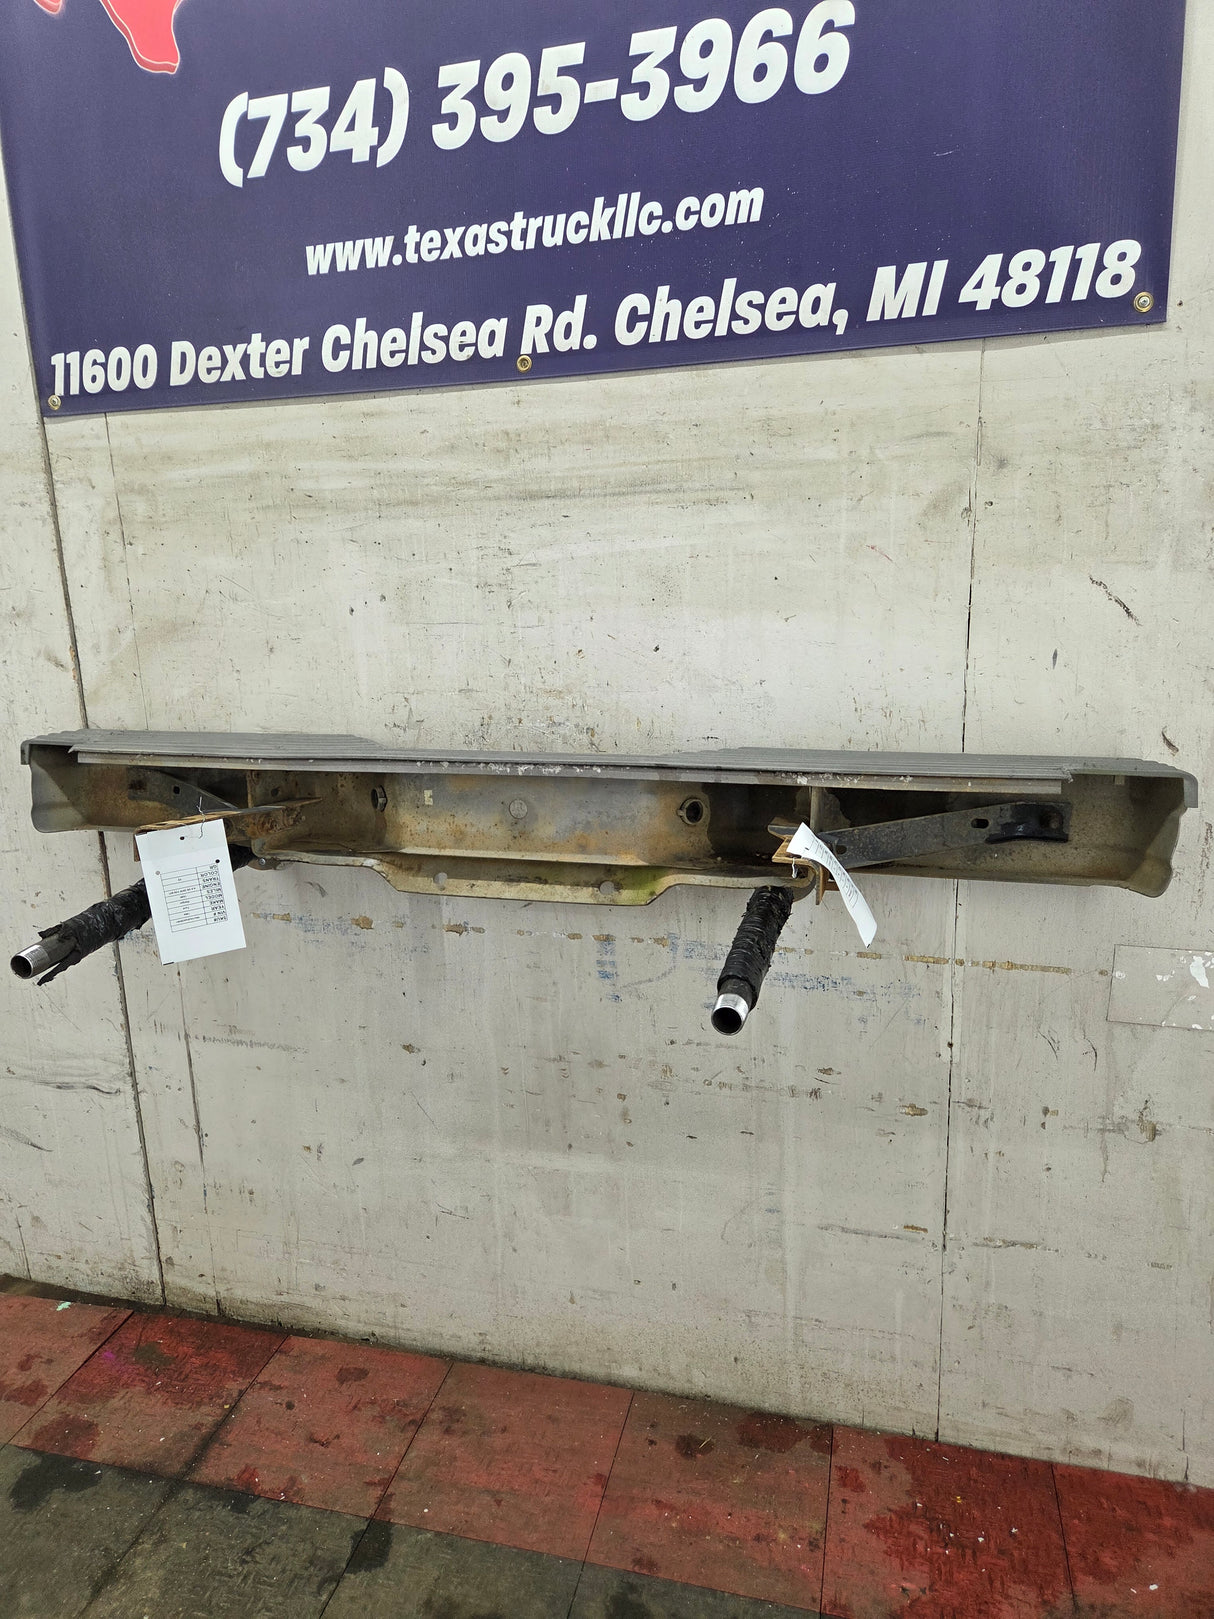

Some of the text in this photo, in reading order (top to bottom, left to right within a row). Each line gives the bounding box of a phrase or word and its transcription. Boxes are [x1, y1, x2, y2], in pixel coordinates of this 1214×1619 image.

[219, 0, 856, 188] (734) 395-3966
[305, 187, 764, 276] www.texastruckllc.com
[49, 240, 1142, 397] 11600 Dexter Chelsea Rd. Chelsea, MI 48118
